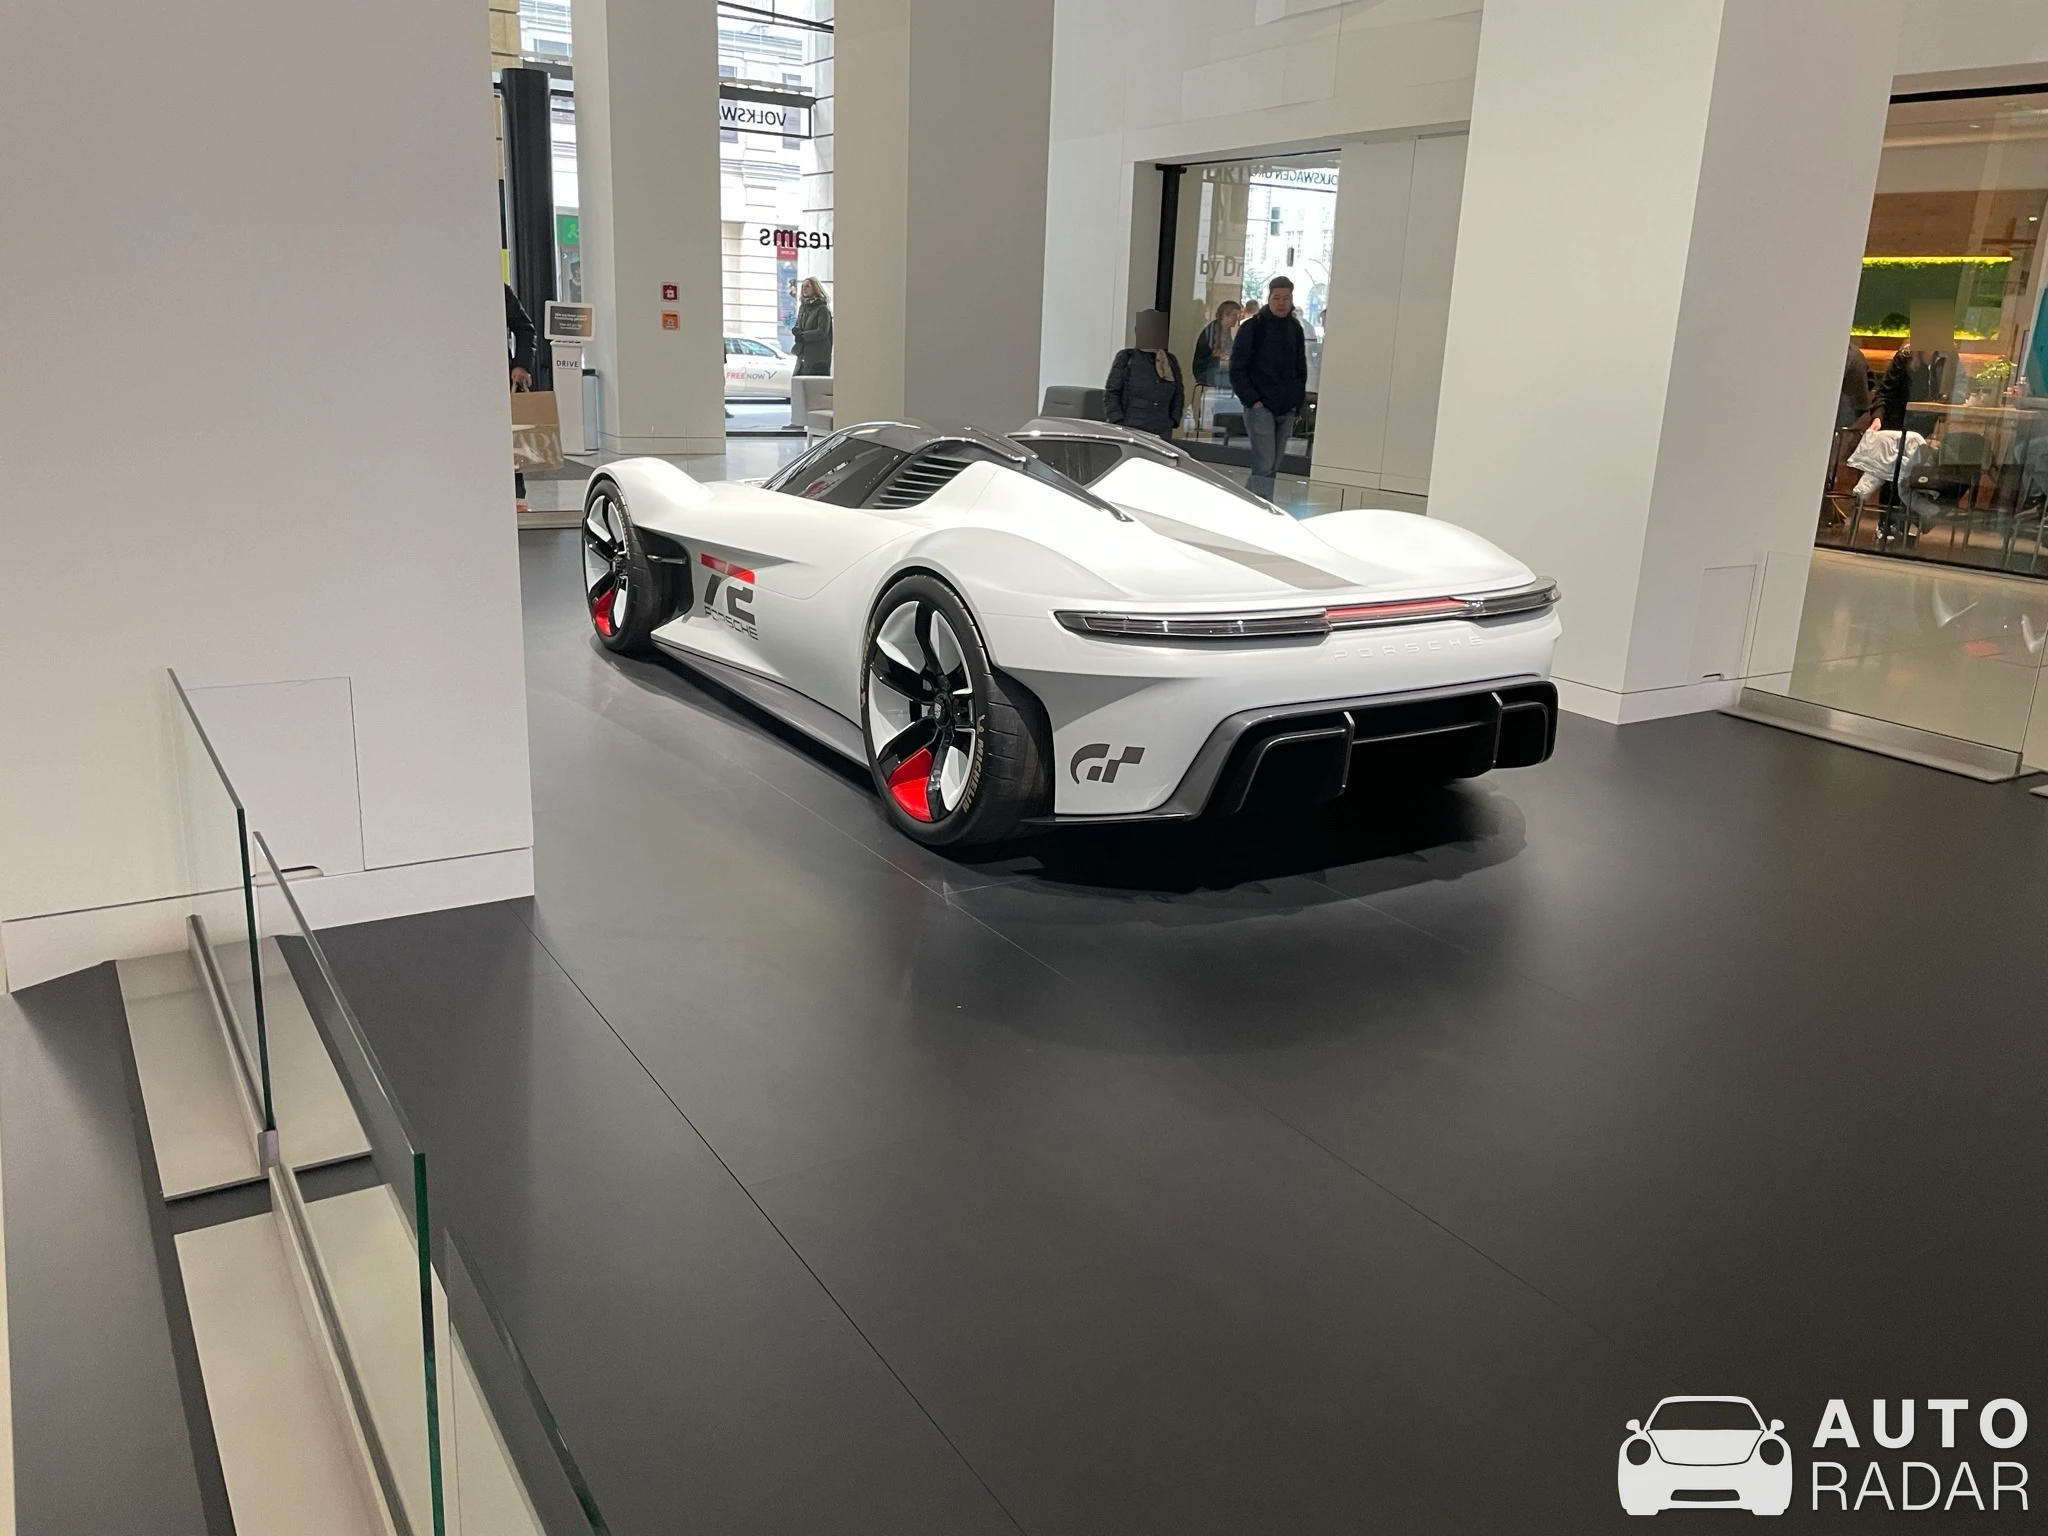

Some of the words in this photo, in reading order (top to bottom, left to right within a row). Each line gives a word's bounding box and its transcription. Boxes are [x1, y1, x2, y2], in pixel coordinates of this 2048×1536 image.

[1200, 254, 1221, 282] by
[726, 371, 745, 380] FREE
[700, 553, 757, 626] 72
[704, 605, 759, 641] PORSCHE
[1333, 635, 1483, 661] PORSCHE
[961, 738, 985, 813] MICHELIN
